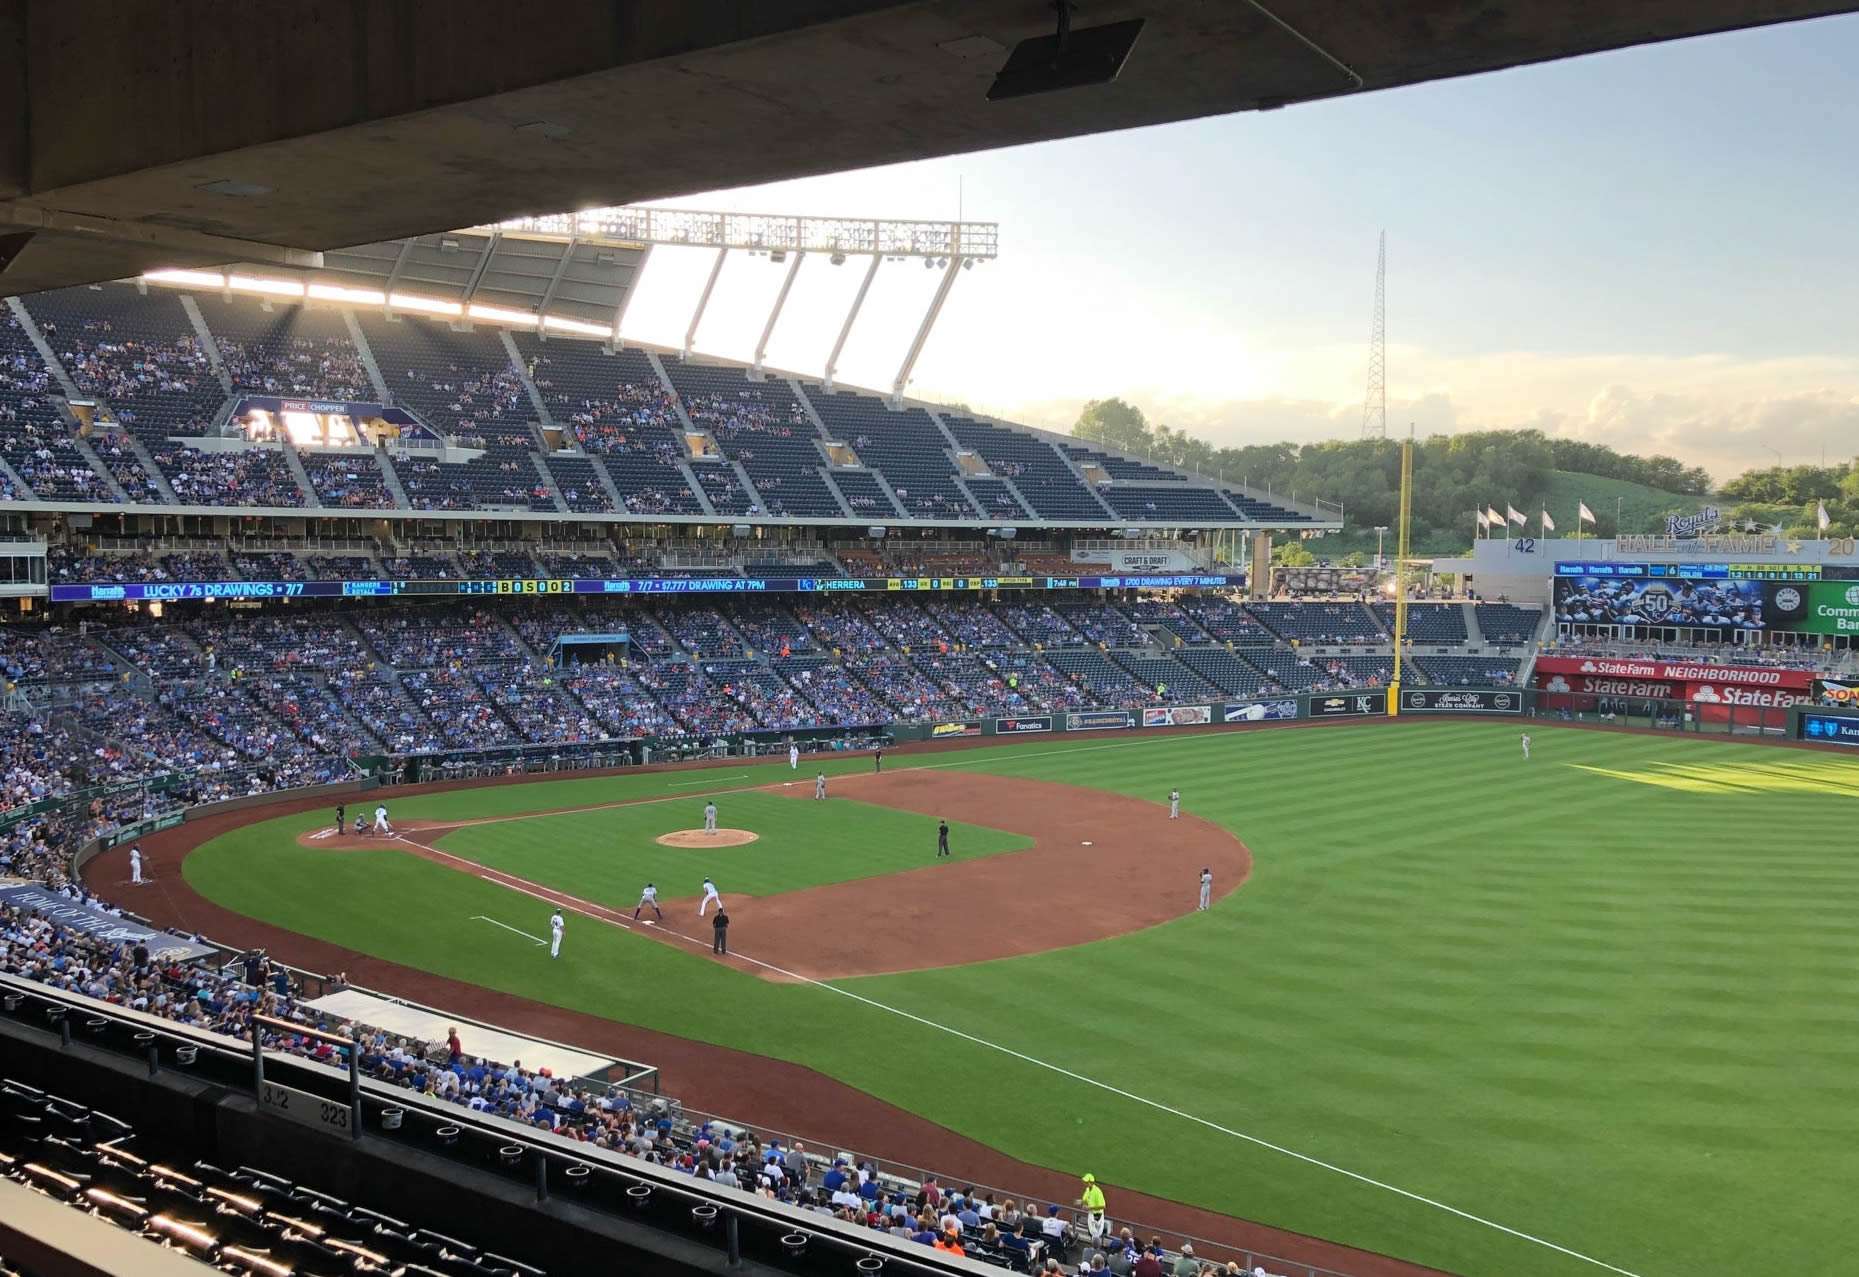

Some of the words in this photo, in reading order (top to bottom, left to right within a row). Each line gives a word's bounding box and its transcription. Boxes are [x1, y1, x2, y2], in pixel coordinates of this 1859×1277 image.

[284, 402, 307, 410] PRICE
[310, 404, 345, 413] CHOPPER
[1666, 506, 1719, 536] Royals
[1514, 538, 1535, 554] 42
[1616, 535, 1677, 553] HALL
[1704, 534, 1776, 554] FAME
[1124, 556, 1143, 565] CRAFT
[1143, 556, 1148, 565] &
[1149, 556, 1168, 565] DRAFT
[1669, 566, 1676, 575] 6
[501, 582, 509, 592] B
[514, 582, 521, 592] 0
[526, 582, 534, 592] S
[539, 581, 545, 592] 0
[563, 582, 570, 591] 2
[638, 581, 653, 591] 7/7
[688, 580, 733, 590] DRAWING
[734, 580, 745, 589] AT
[747, 580, 765, 590] 7PM
[826, 580, 865, 589] HERRERA
[901, 579, 918, 588] .133
[932, 579, 938, 588] 0
[958, 579, 964, 588] 0
[981, 579, 997, 588] .133
[1141, 578, 1172, 586] DRAWING
[1174, 577, 1194, 585] EVERY
[1194, 577, 1199, 585] 7
[1200, 577, 1226, 585] MINUTES
[143, 584, 185, 597] LUCKY
[188, 584, 202, 596] 7s
[204, 583, 274, 596] DRAWINGS
[286, 583, 304, 596] 7/7
[1645, 595, 1668, 611] 50
[1836, 618, 1859, 630] Ba
[1664, 666, 1780, 684] NEIGHBORHOOD
[1356, 696, 1372, 713] KC
[1016, 722, 1042, 730] Fanatics
[178, 772, 196, 781] Cboe
[104, 785, 120, 794] Cboe
[11, 891, 65, 911] HOME
[52, 907, 86, 919] OF
[72, 915, 116, 931] THE
[321, 1102, 347, 1128] 323
